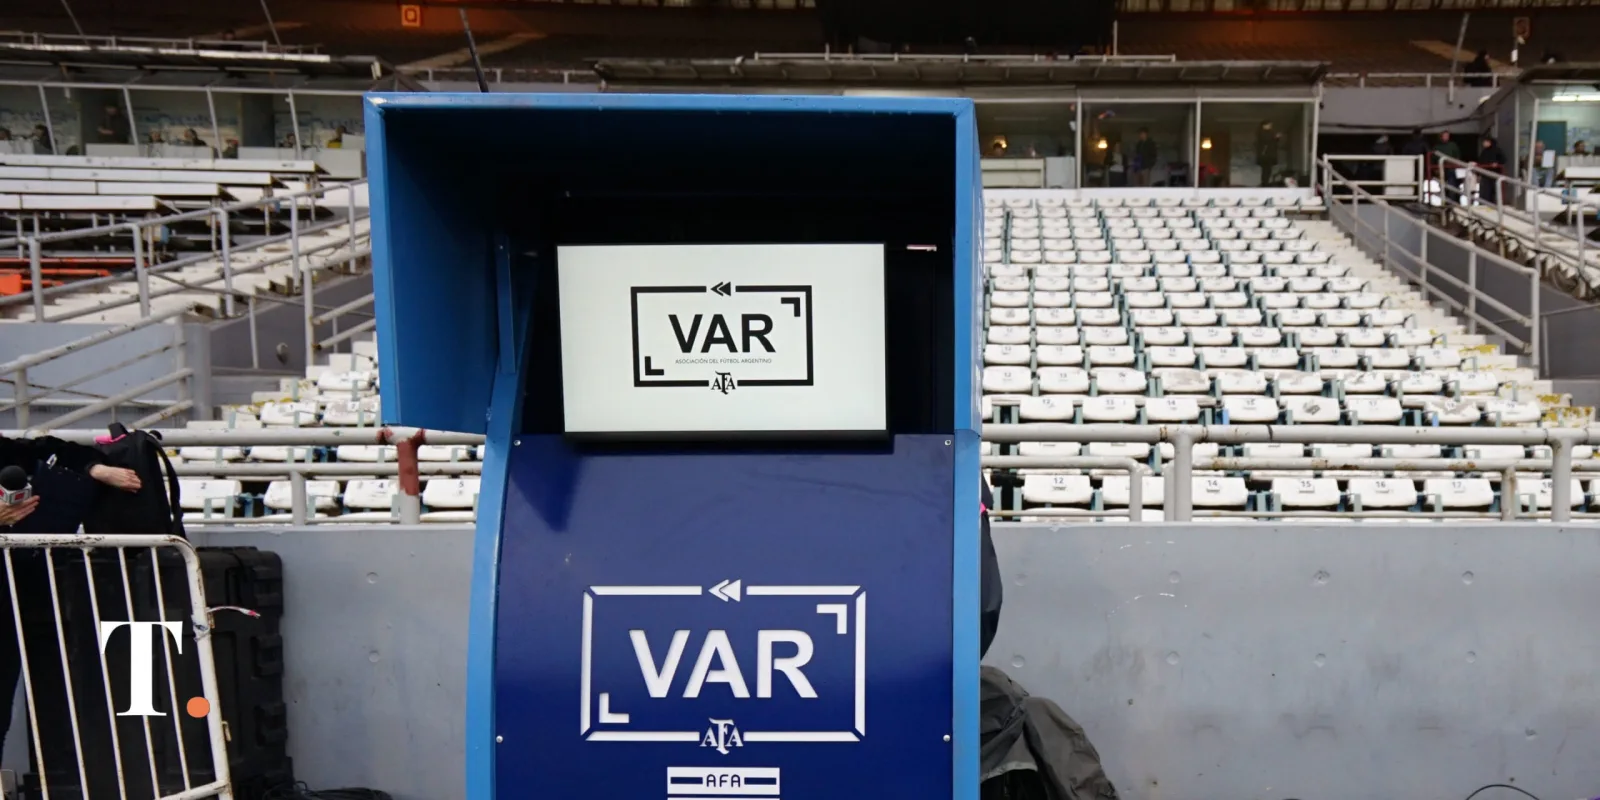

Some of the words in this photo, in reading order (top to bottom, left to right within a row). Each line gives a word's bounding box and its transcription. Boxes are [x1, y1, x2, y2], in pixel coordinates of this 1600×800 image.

[668, 313, 776, 354] VAR
[719, 356, 740, 364] FÚTBOL
[1053, 477, 1064, 485] 12
[1207, 479, 1218, 487] 14
[1376, 480, 1386, 488] 16
[629, 629, 818, 699] VAR
[706, 773, 741, 788] AFA
